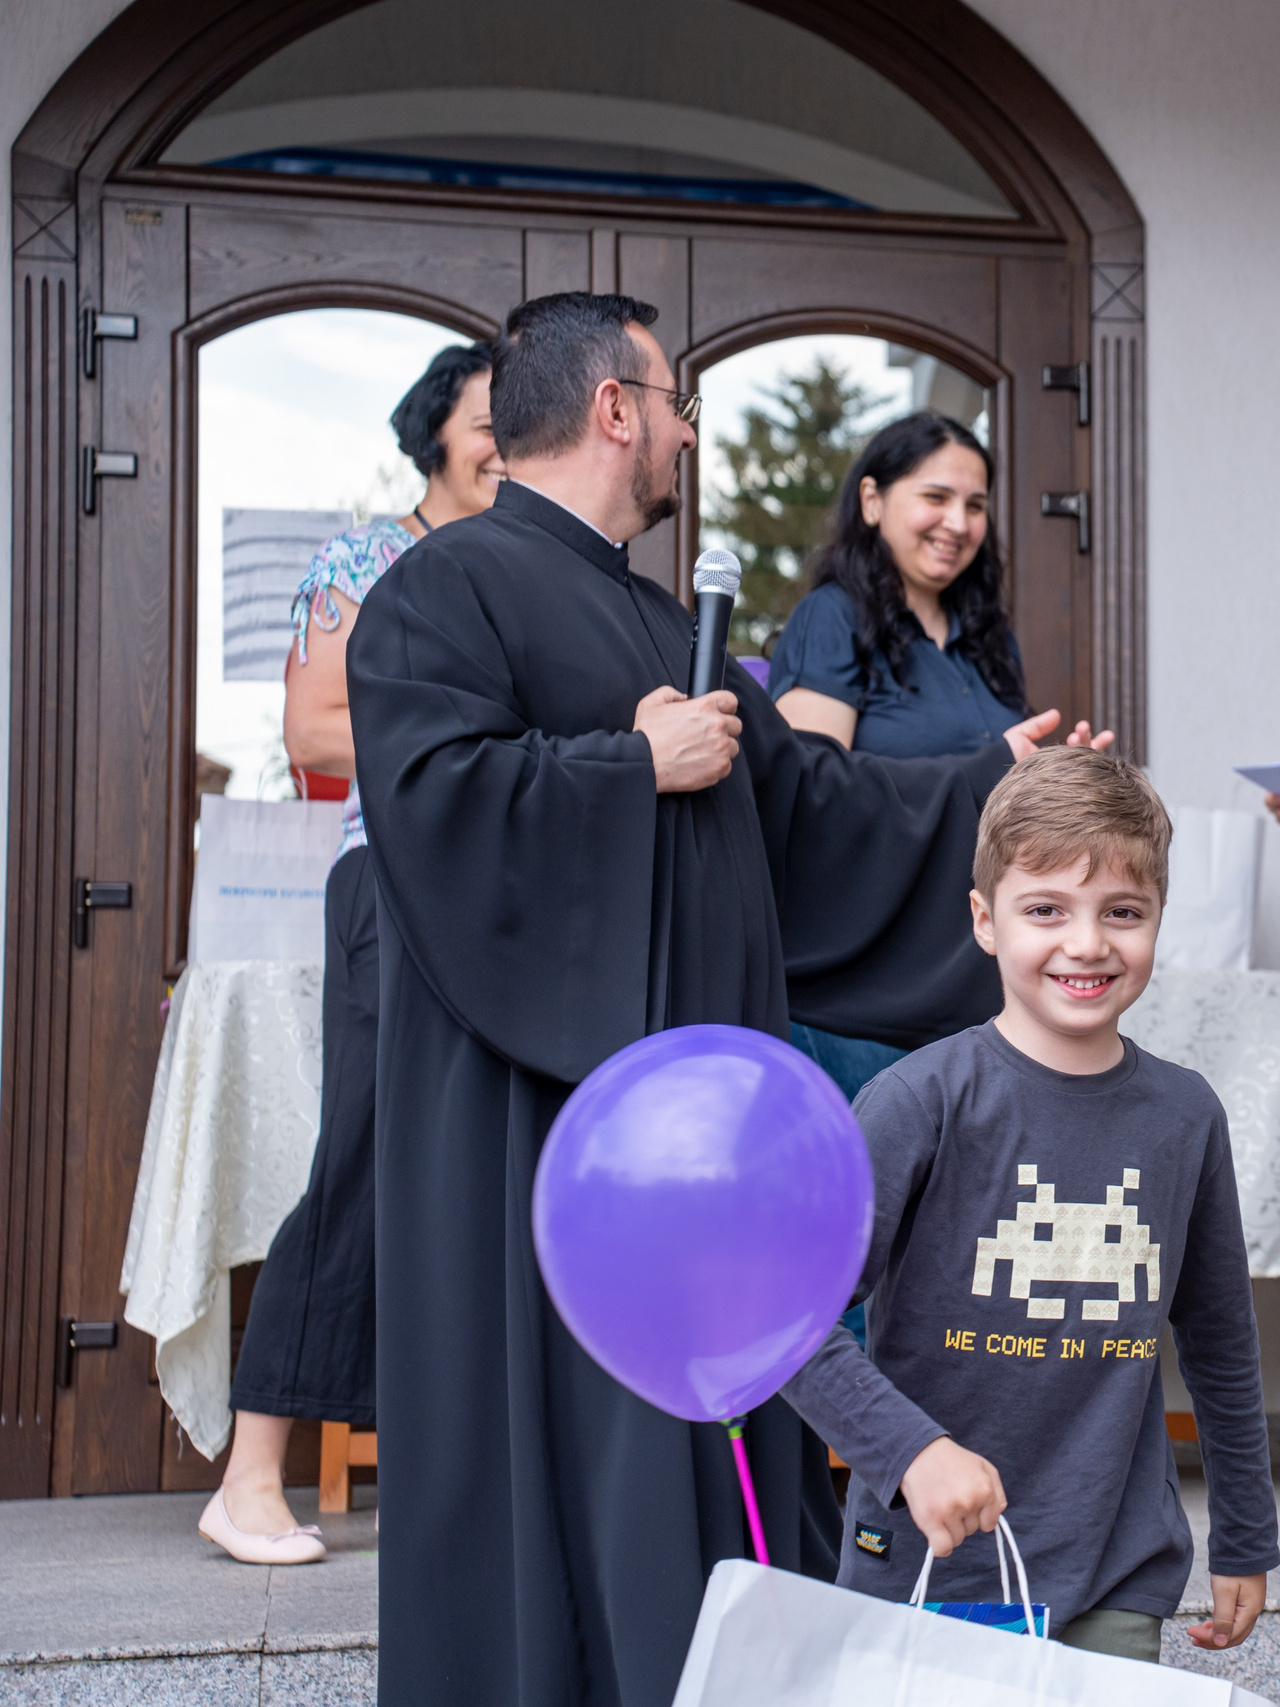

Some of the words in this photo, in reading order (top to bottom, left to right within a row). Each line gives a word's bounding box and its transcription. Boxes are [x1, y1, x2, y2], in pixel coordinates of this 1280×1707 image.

[945, 1329, 976, 1351] WE
[986, 1334, 1047, 1357] COME
[1060, 1339, 1085, 1358] IN
